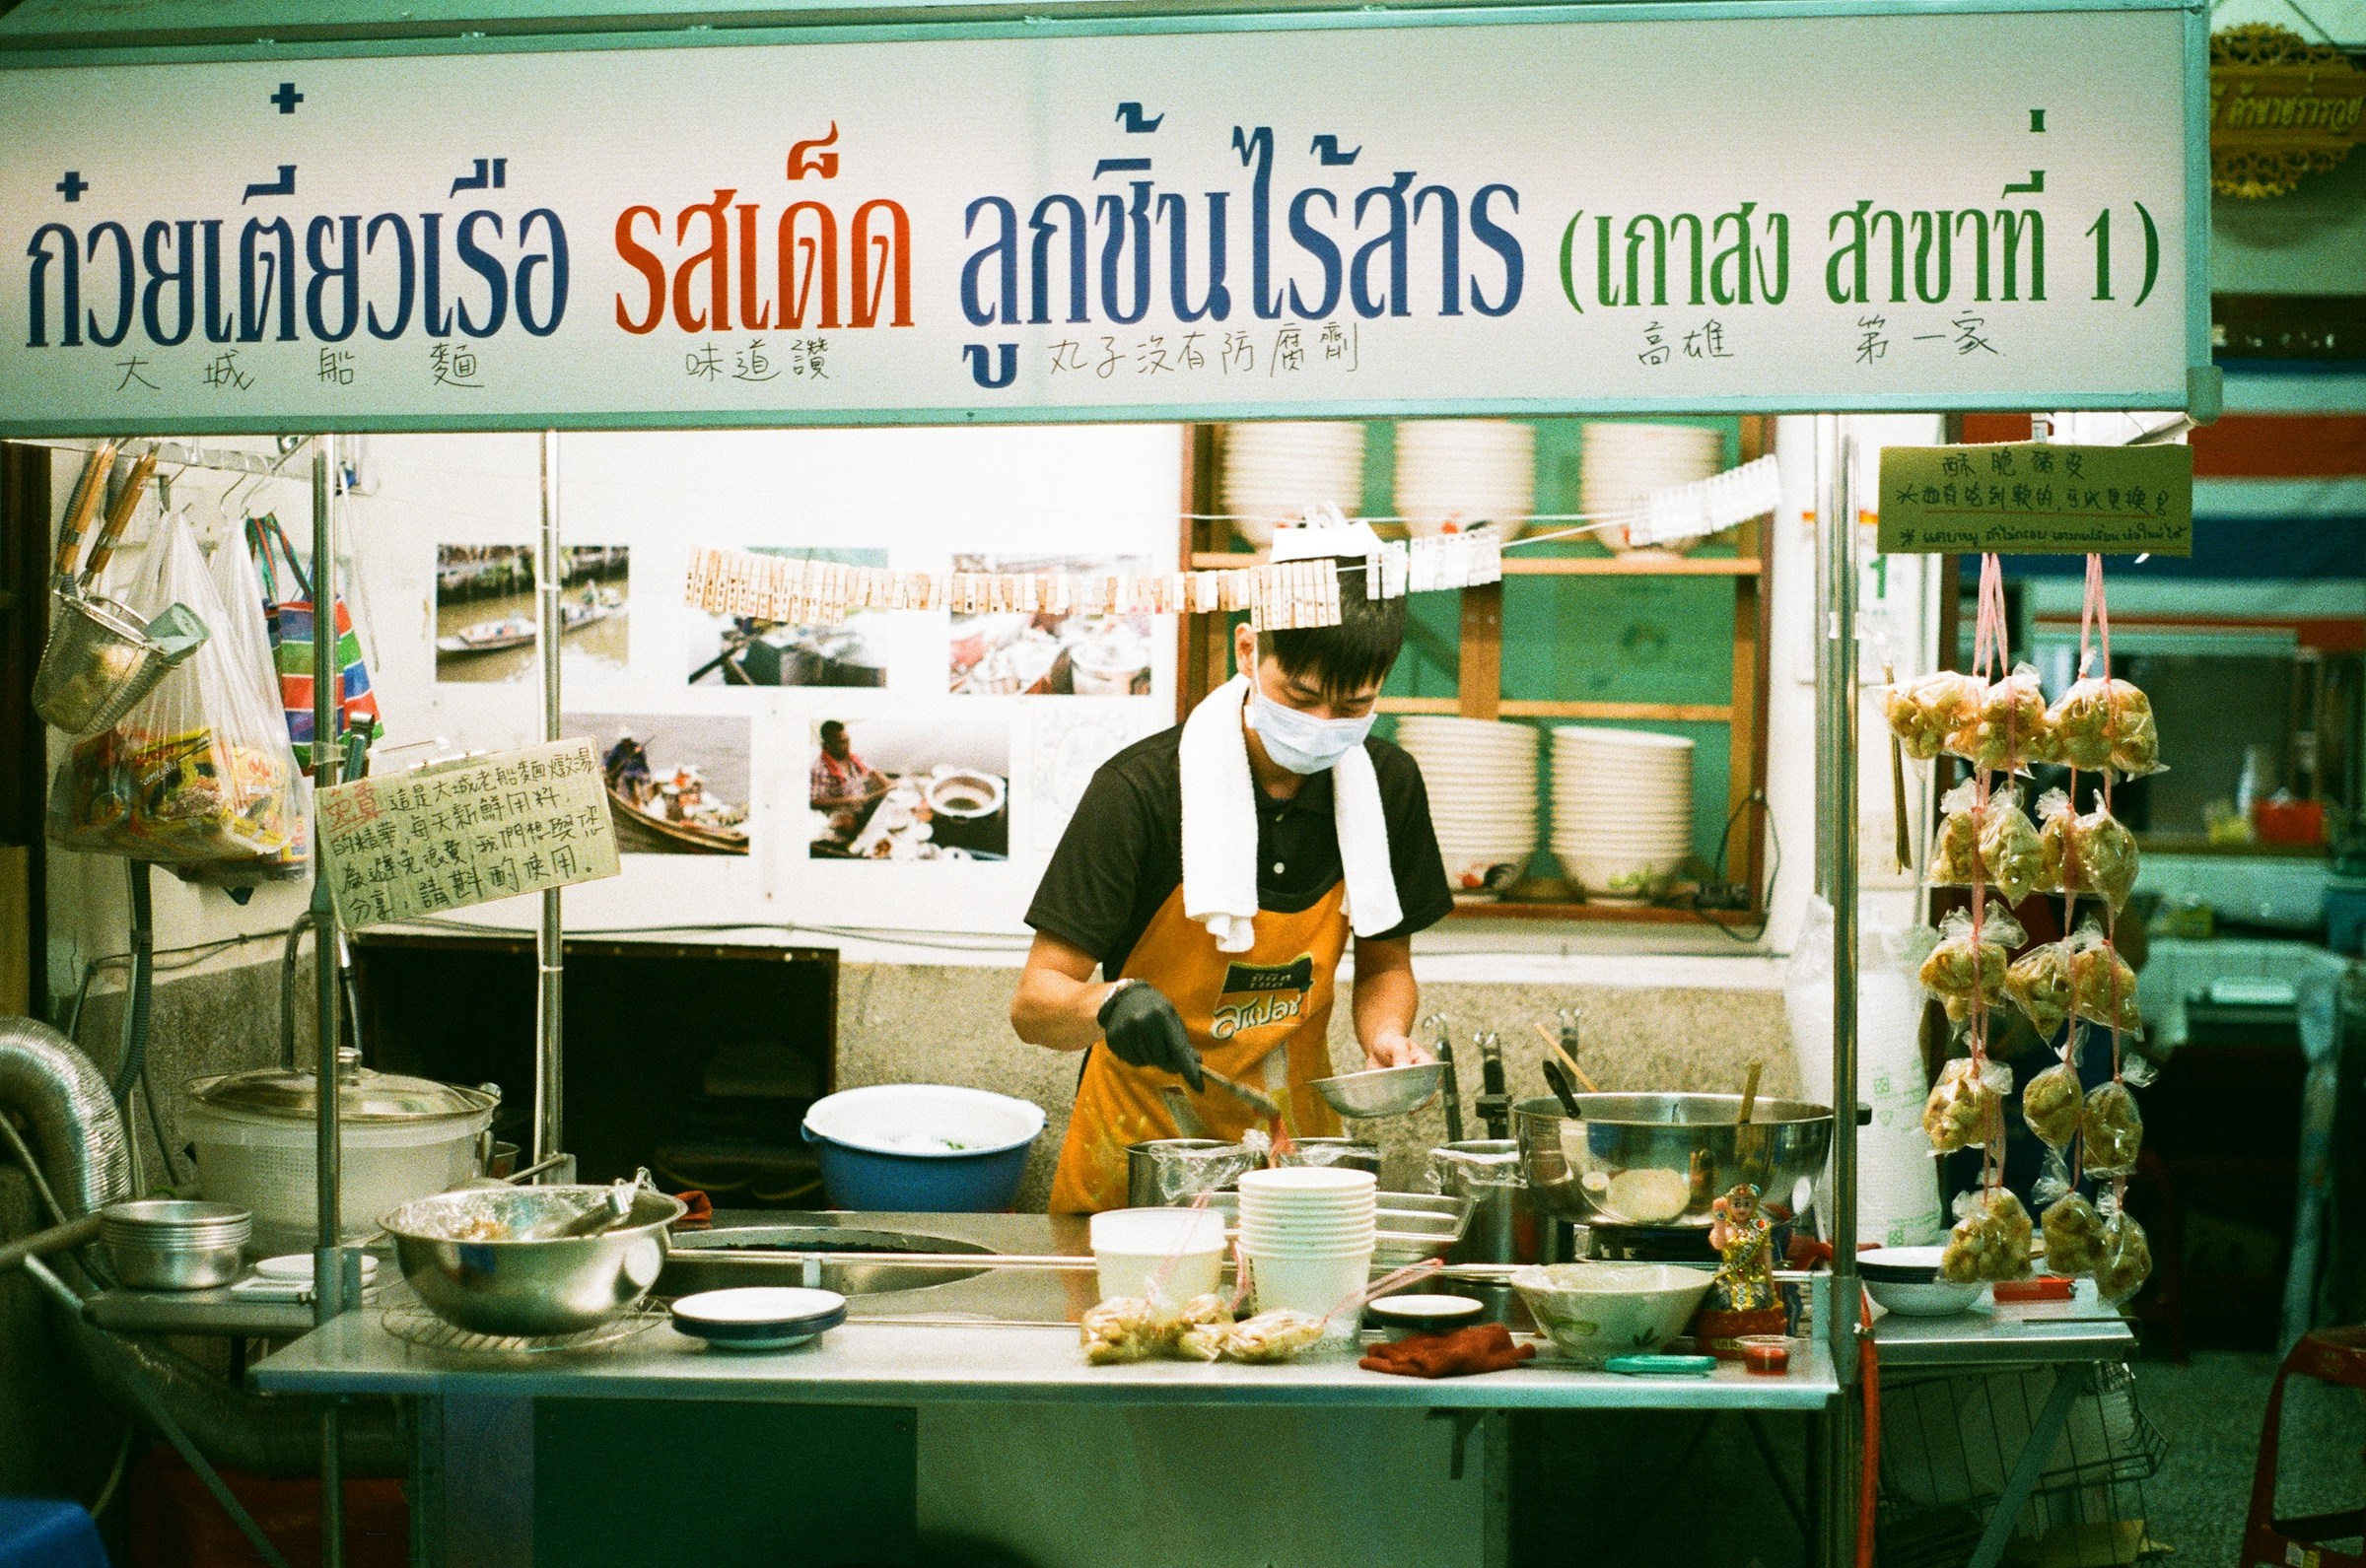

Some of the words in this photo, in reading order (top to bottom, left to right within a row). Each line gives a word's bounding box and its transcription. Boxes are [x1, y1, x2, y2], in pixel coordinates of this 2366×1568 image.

[26, 82, 570, 348] ก๋วยเตี๋ยวเรือ
[615, 121, 915, 335] รสเด็ด
[960, 102, 1524, 388] ลูกชิ้นไร้สาร
[1560, 201, 1789, 314] (เกาสง
[1825, 108, 2047, 305] สาขาที่
[1047, 321, 1359, 379] 丸子沒有防腐劑
[1636, 318, 1735, 366] 高雄
[1855, 309, 2000, 365] 第一家
